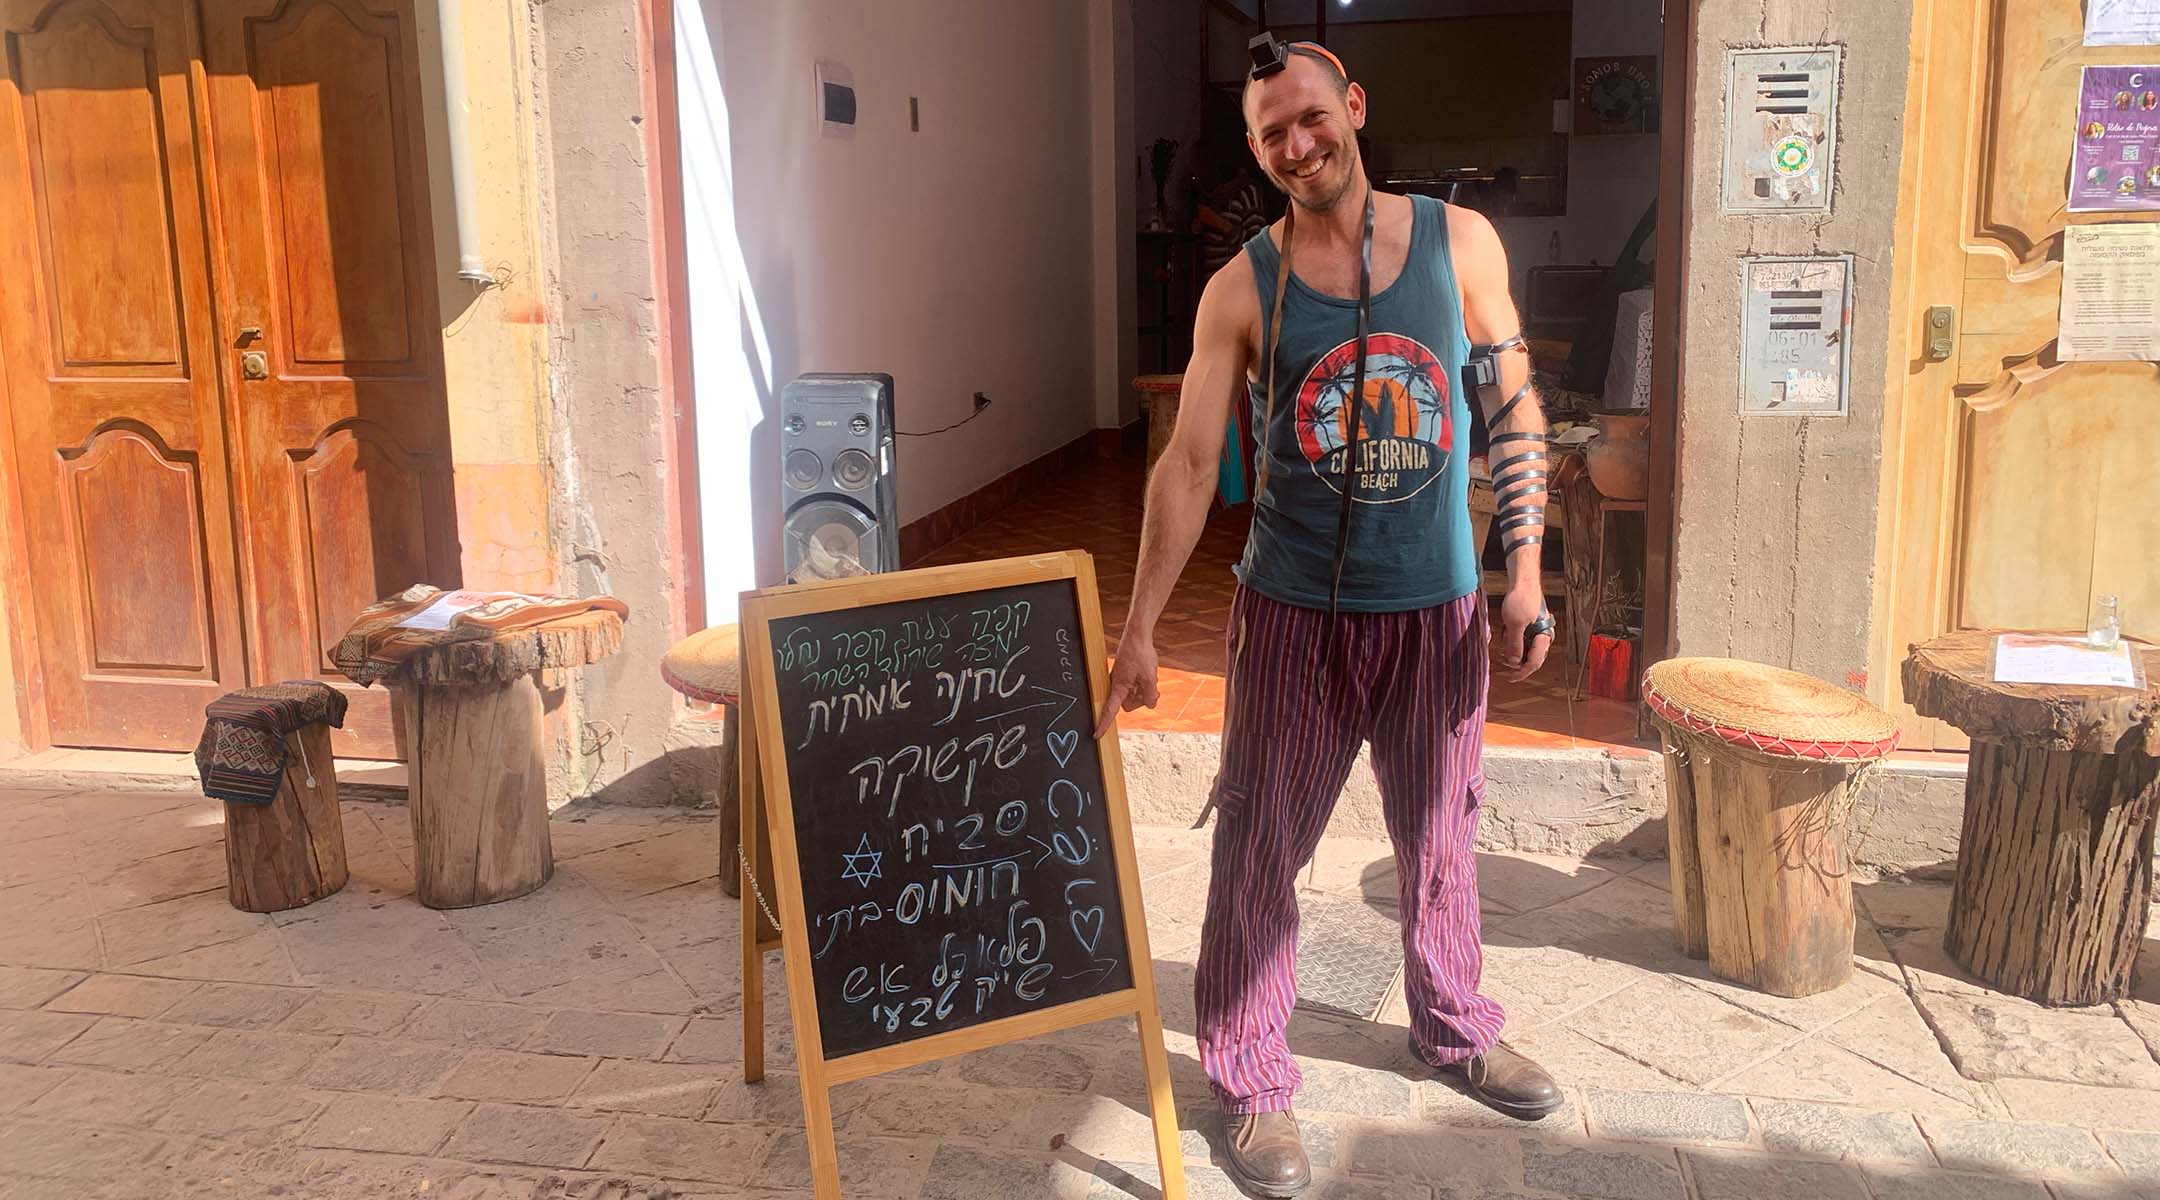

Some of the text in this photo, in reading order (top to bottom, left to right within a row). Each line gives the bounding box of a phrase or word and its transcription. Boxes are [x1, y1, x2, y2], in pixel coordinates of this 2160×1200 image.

[1361, 473, 1398, 491] BEACH
[971, 600, 1031, 638] קפה
[832, 628, 886, 665] קפה
[955, 633, 1012, 662] מצה
[801, 663, 869, 693] השחר
[797, 645, 1030, 751] טחינה אמיתית
[848, 723, 1028, 818] שקשוקה
[901, 800, 1028, 863] סביח
[843, 963, 910, 1003] אש
[871, 979, 961, 1033] טבעי
